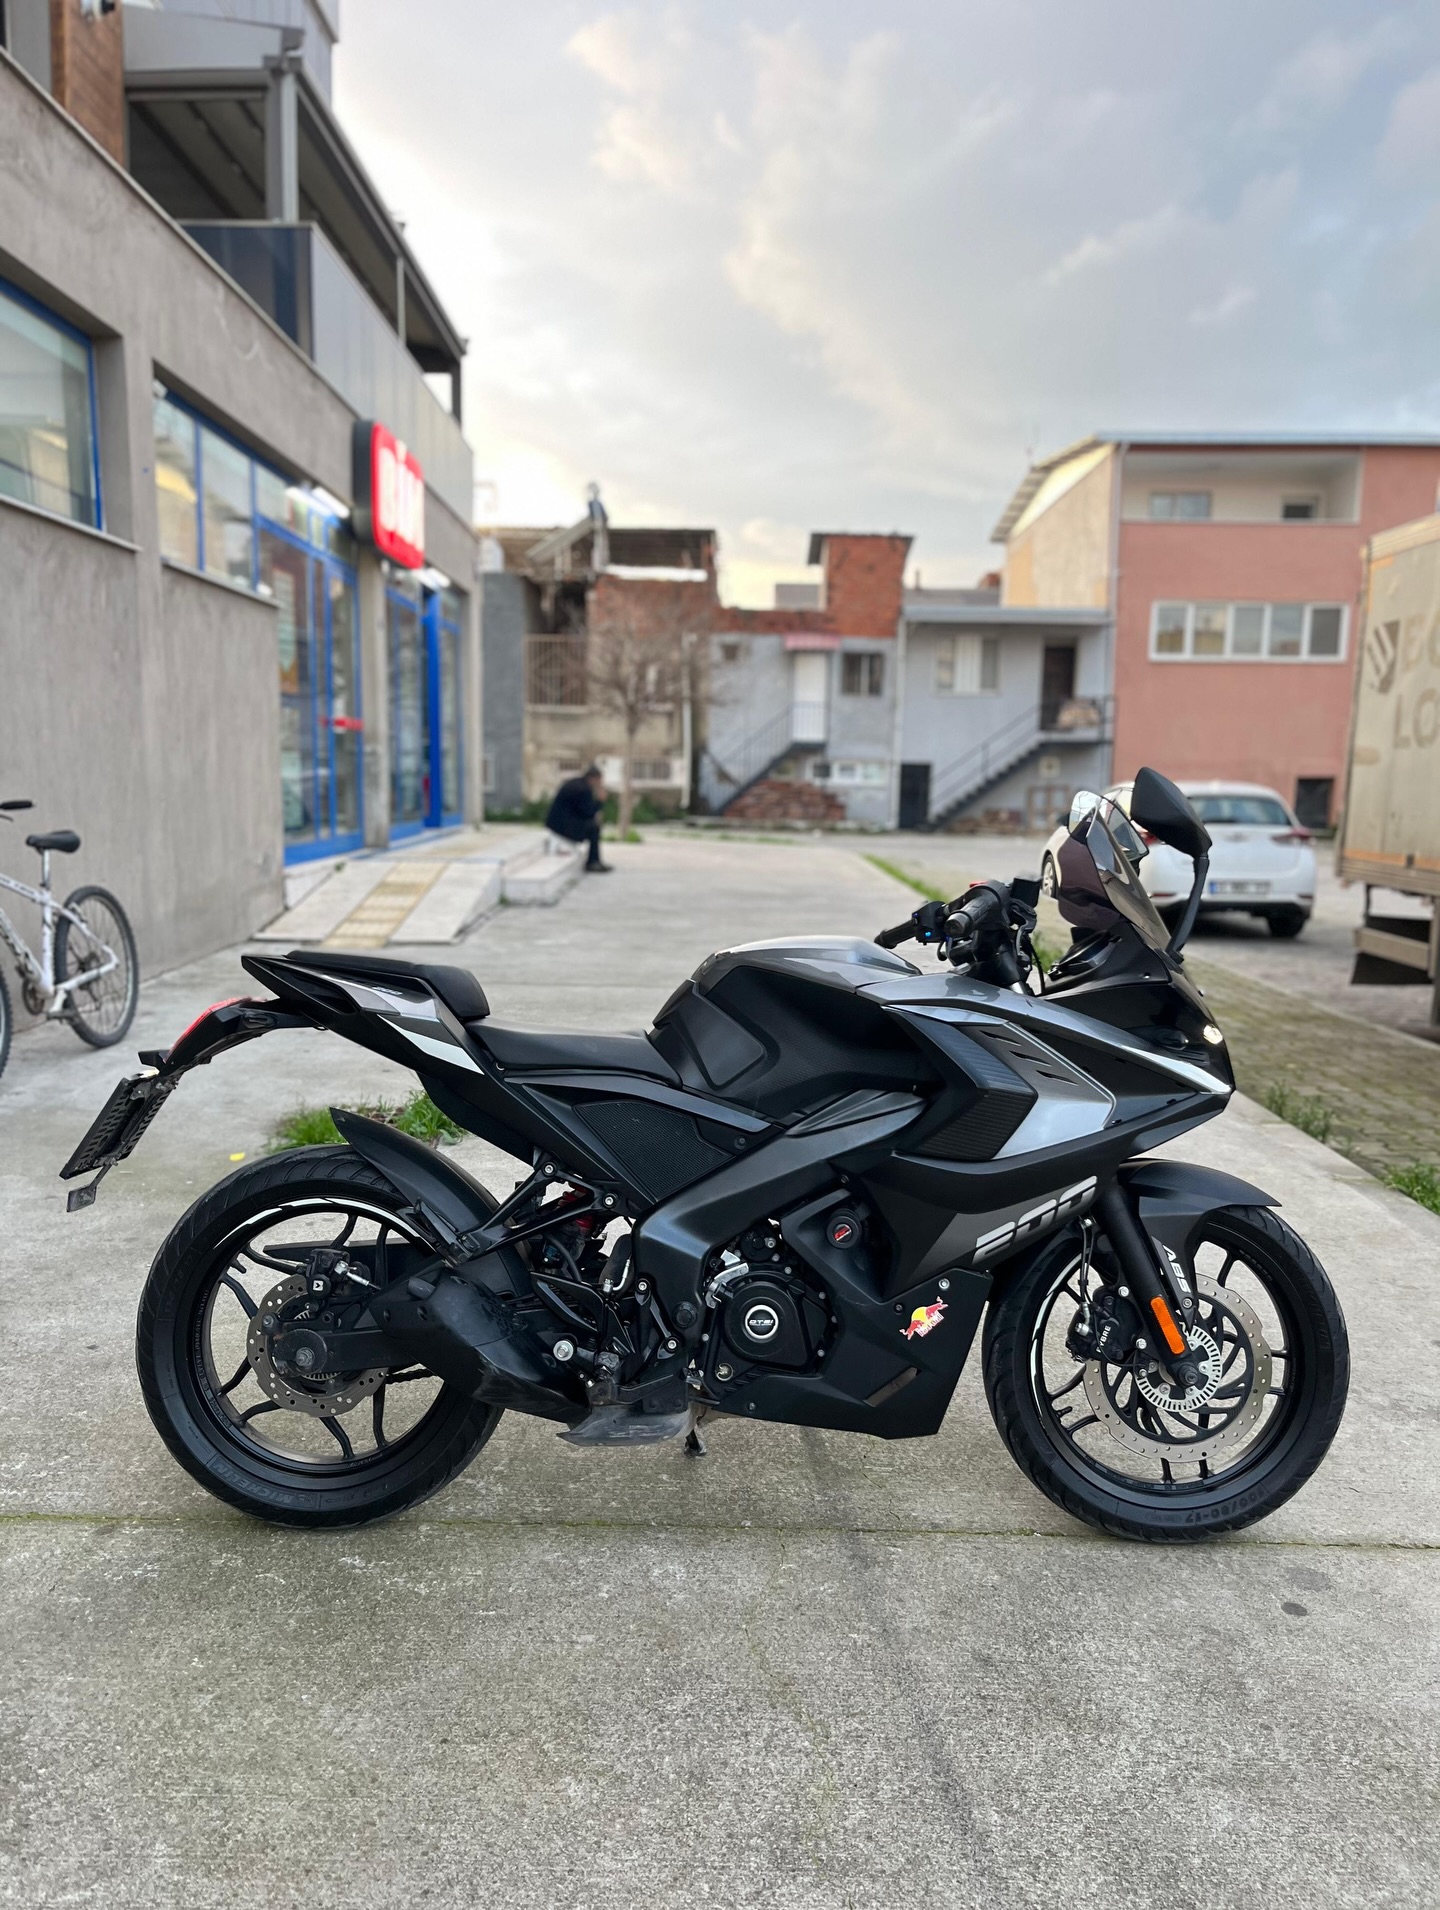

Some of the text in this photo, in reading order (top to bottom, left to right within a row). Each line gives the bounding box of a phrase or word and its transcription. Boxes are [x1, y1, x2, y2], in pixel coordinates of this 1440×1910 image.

[972, 1175, 1097, 1265] 200
[1162, 1244, 1191, 1293] ABS
[212, 1460, 294, 1504] MICHELIN
